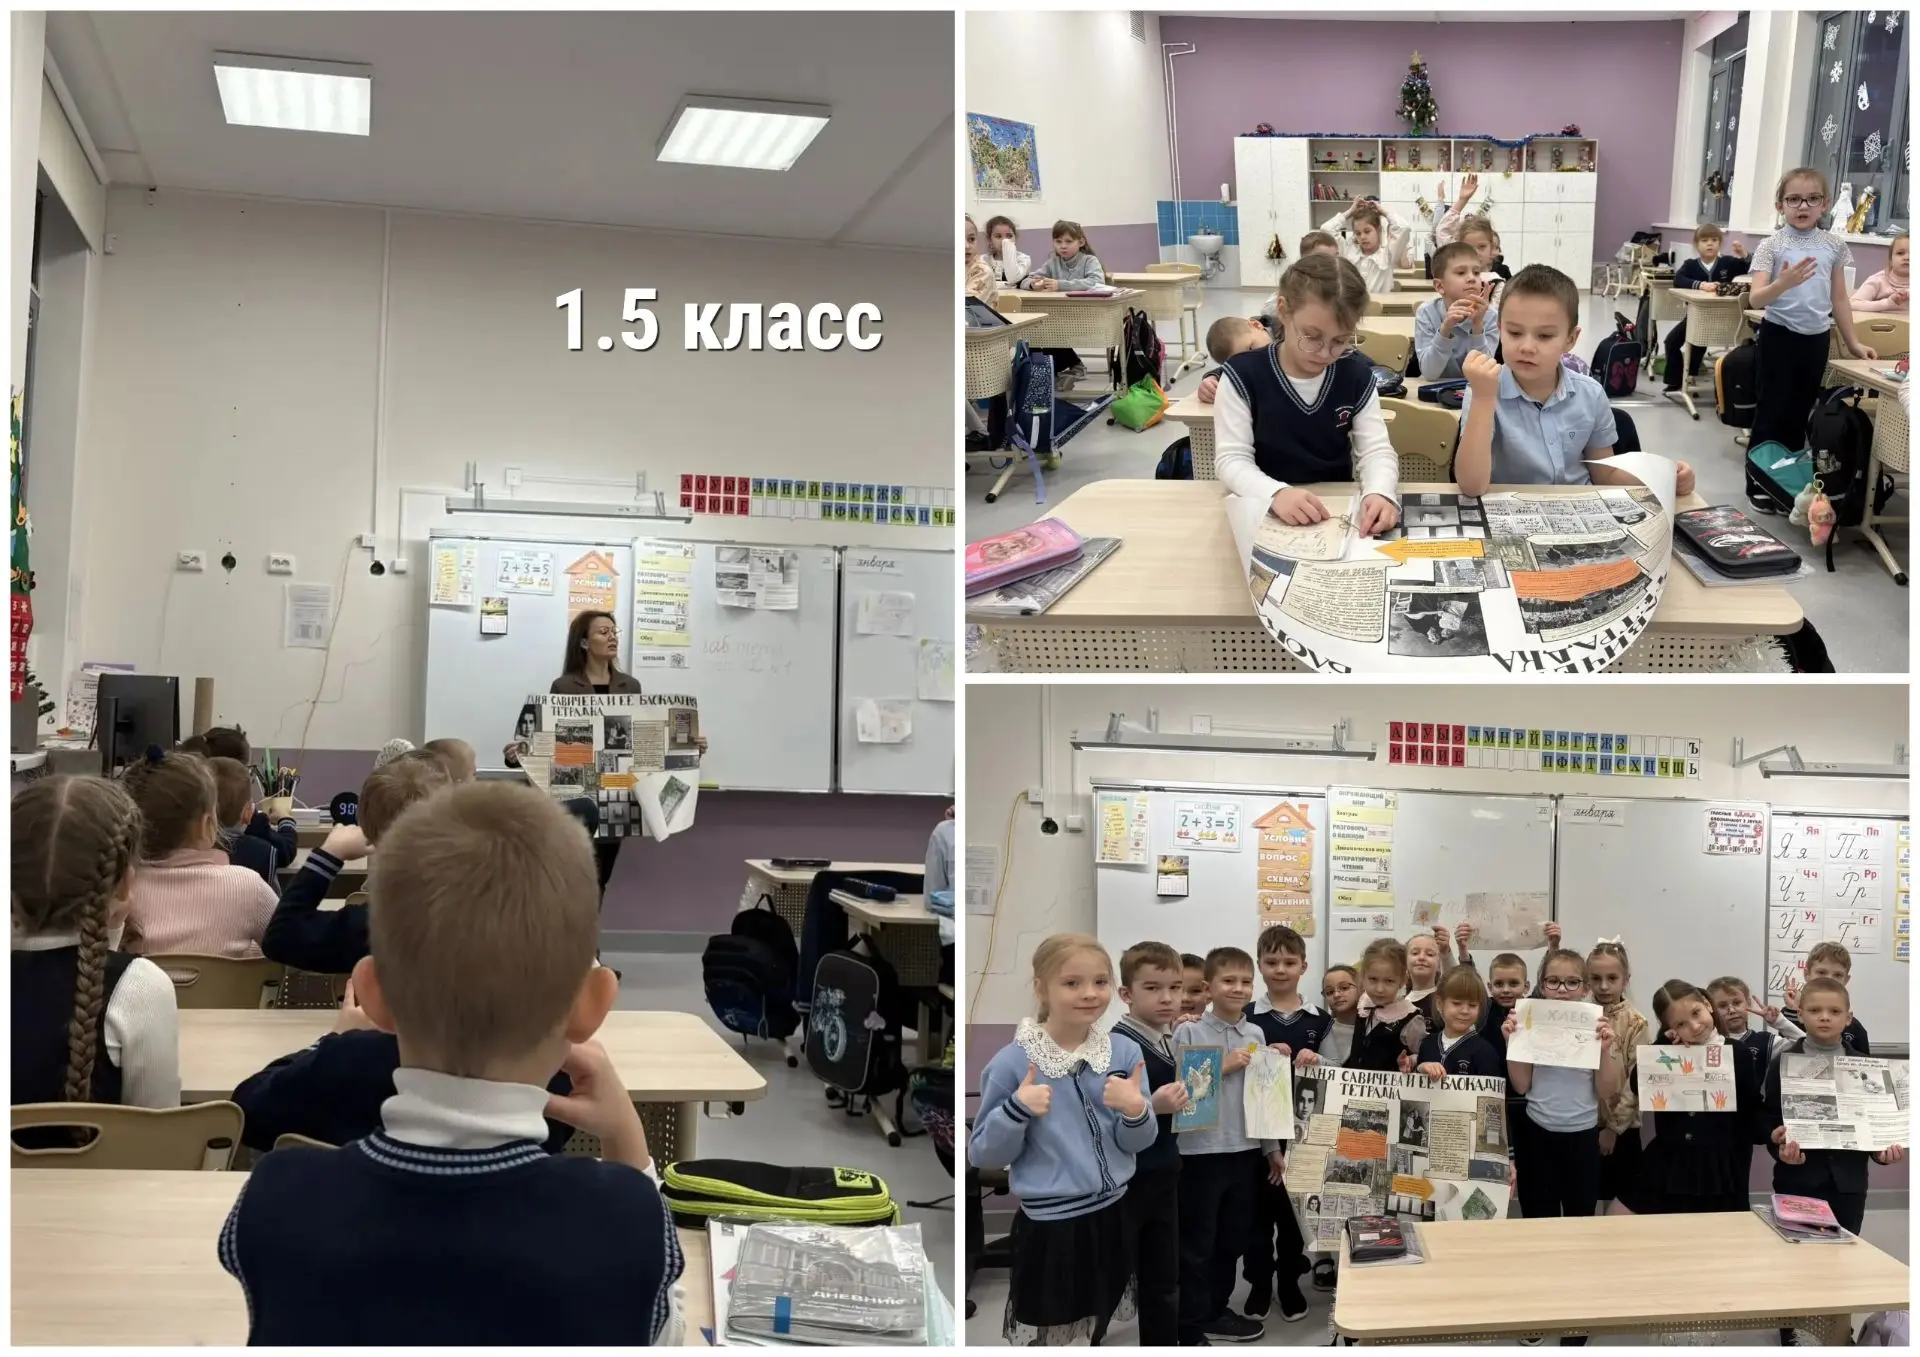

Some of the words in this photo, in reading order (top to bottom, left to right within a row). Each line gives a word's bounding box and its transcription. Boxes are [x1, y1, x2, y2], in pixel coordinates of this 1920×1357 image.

[1573, 803, 1616, 822] января
[1806, 826, 1819, 835] Яя
[1866, 827, 1879, 836] Пп
[1263, 834, 1308, 843] УСЛОВИЕ
[1260, 853, 1298, 861] ВОПРОС
[1266, 875, 1299, 883] СХЕМА
[1267, 897, 1310, 905] РЕШЕНИЕ
[1547, 1009, 1590, 1023] ХЛЕБ
[1341, 1070, 1403, 1087] САВИЧЕВА
[1340, 1083, 1400, 1100] ТЕТРАДКА
